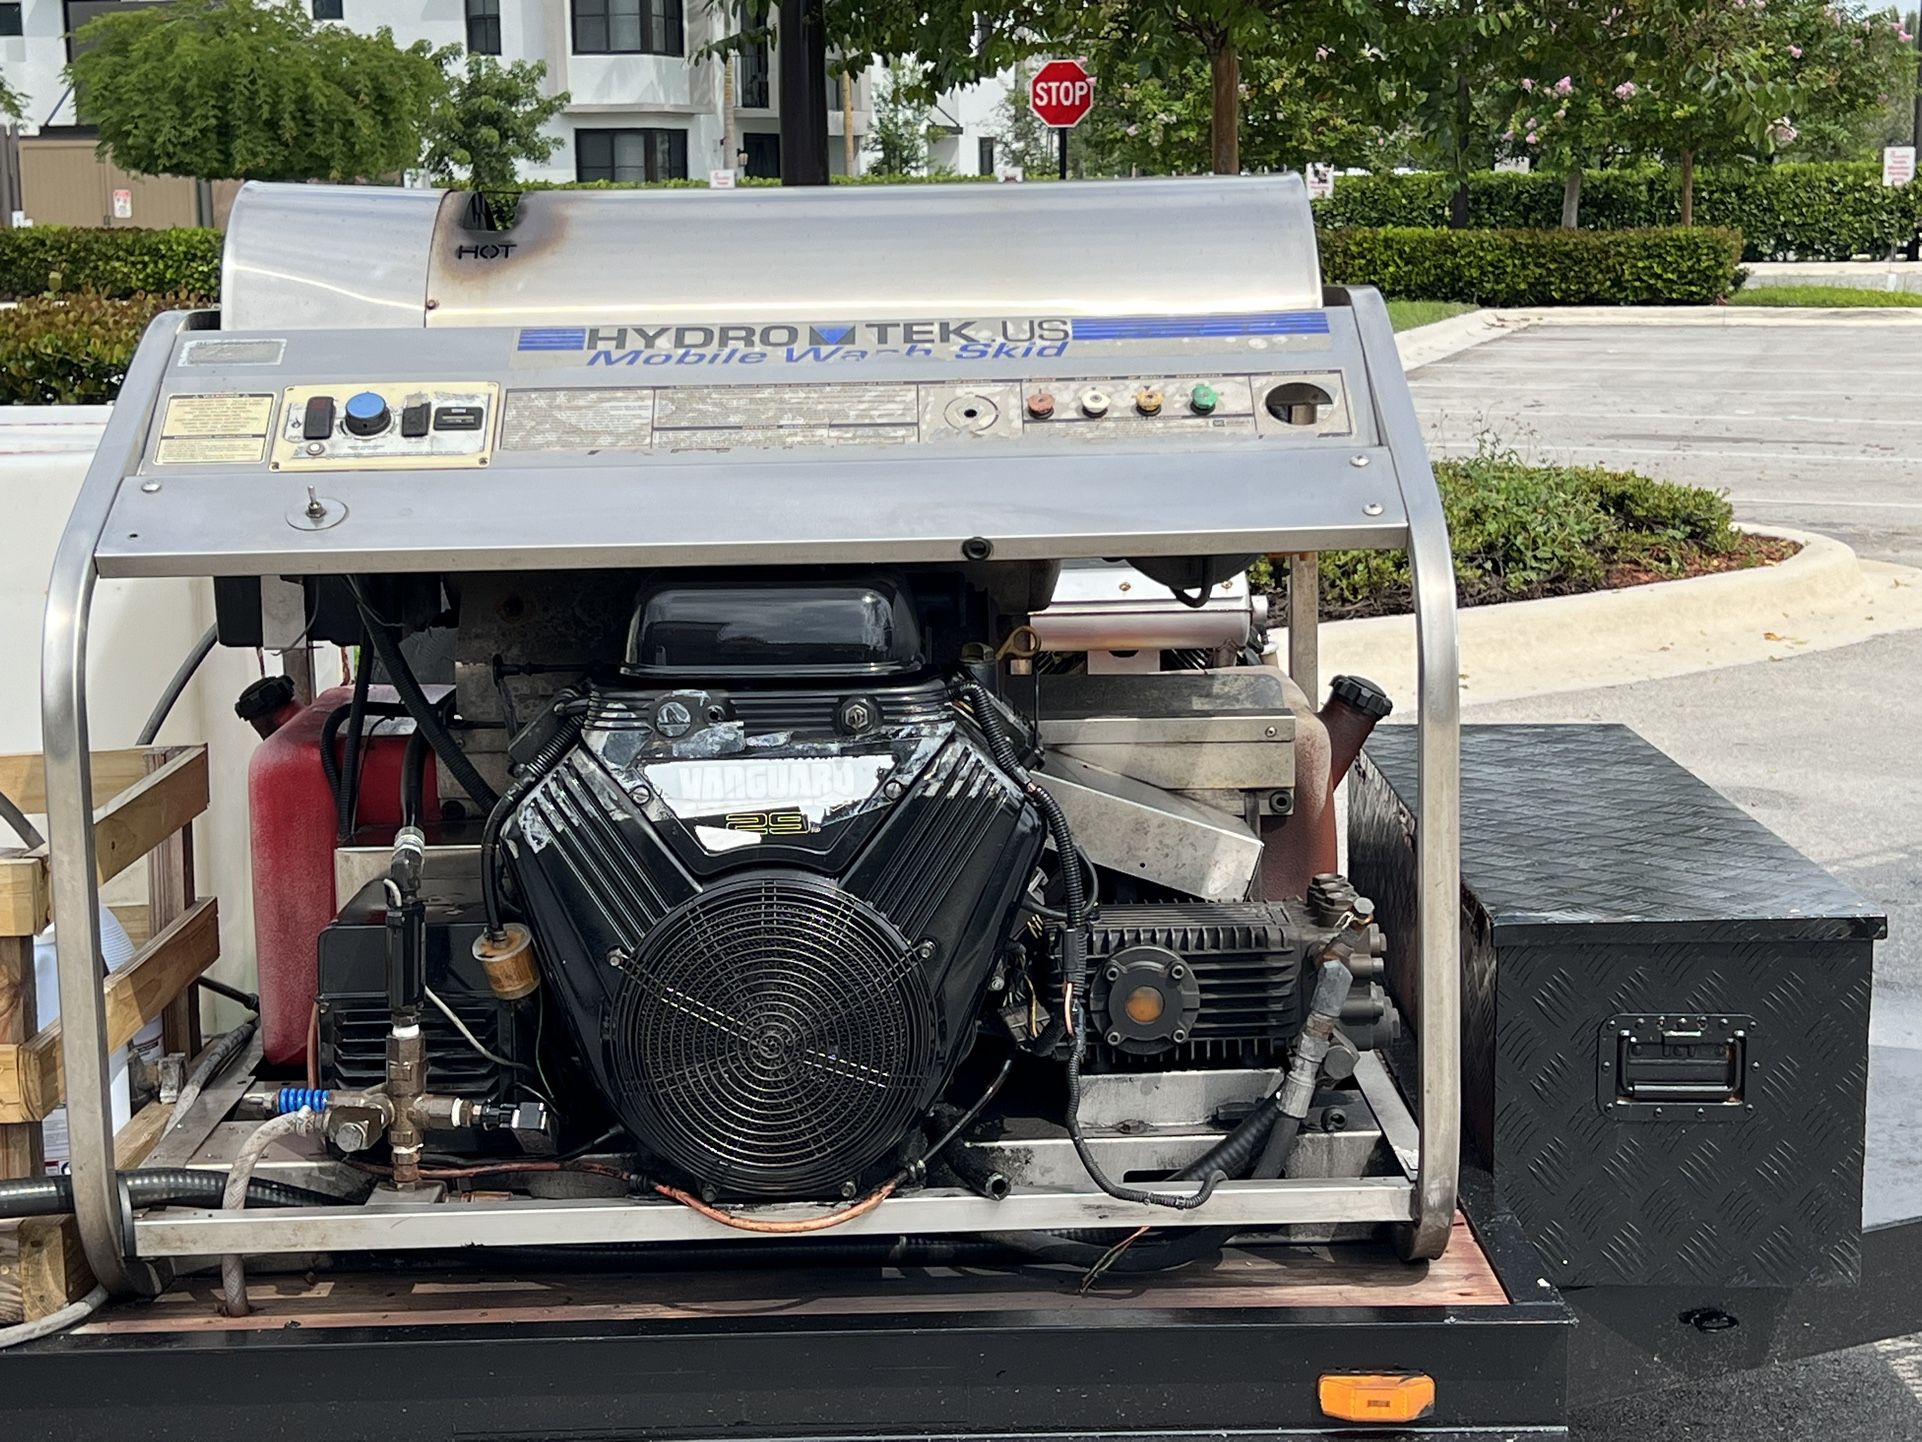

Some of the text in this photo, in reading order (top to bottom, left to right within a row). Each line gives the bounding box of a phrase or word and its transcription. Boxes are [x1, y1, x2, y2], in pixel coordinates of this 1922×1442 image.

[1035, 81, 1088, 106] STOP
[458, 243, 518, 259] HOT
[586, 325, 798, 350] HYDRO
[586, 341, 1070, 366] Mobile Wah Skid
[679, 762, 855, 800] VANGUARD
